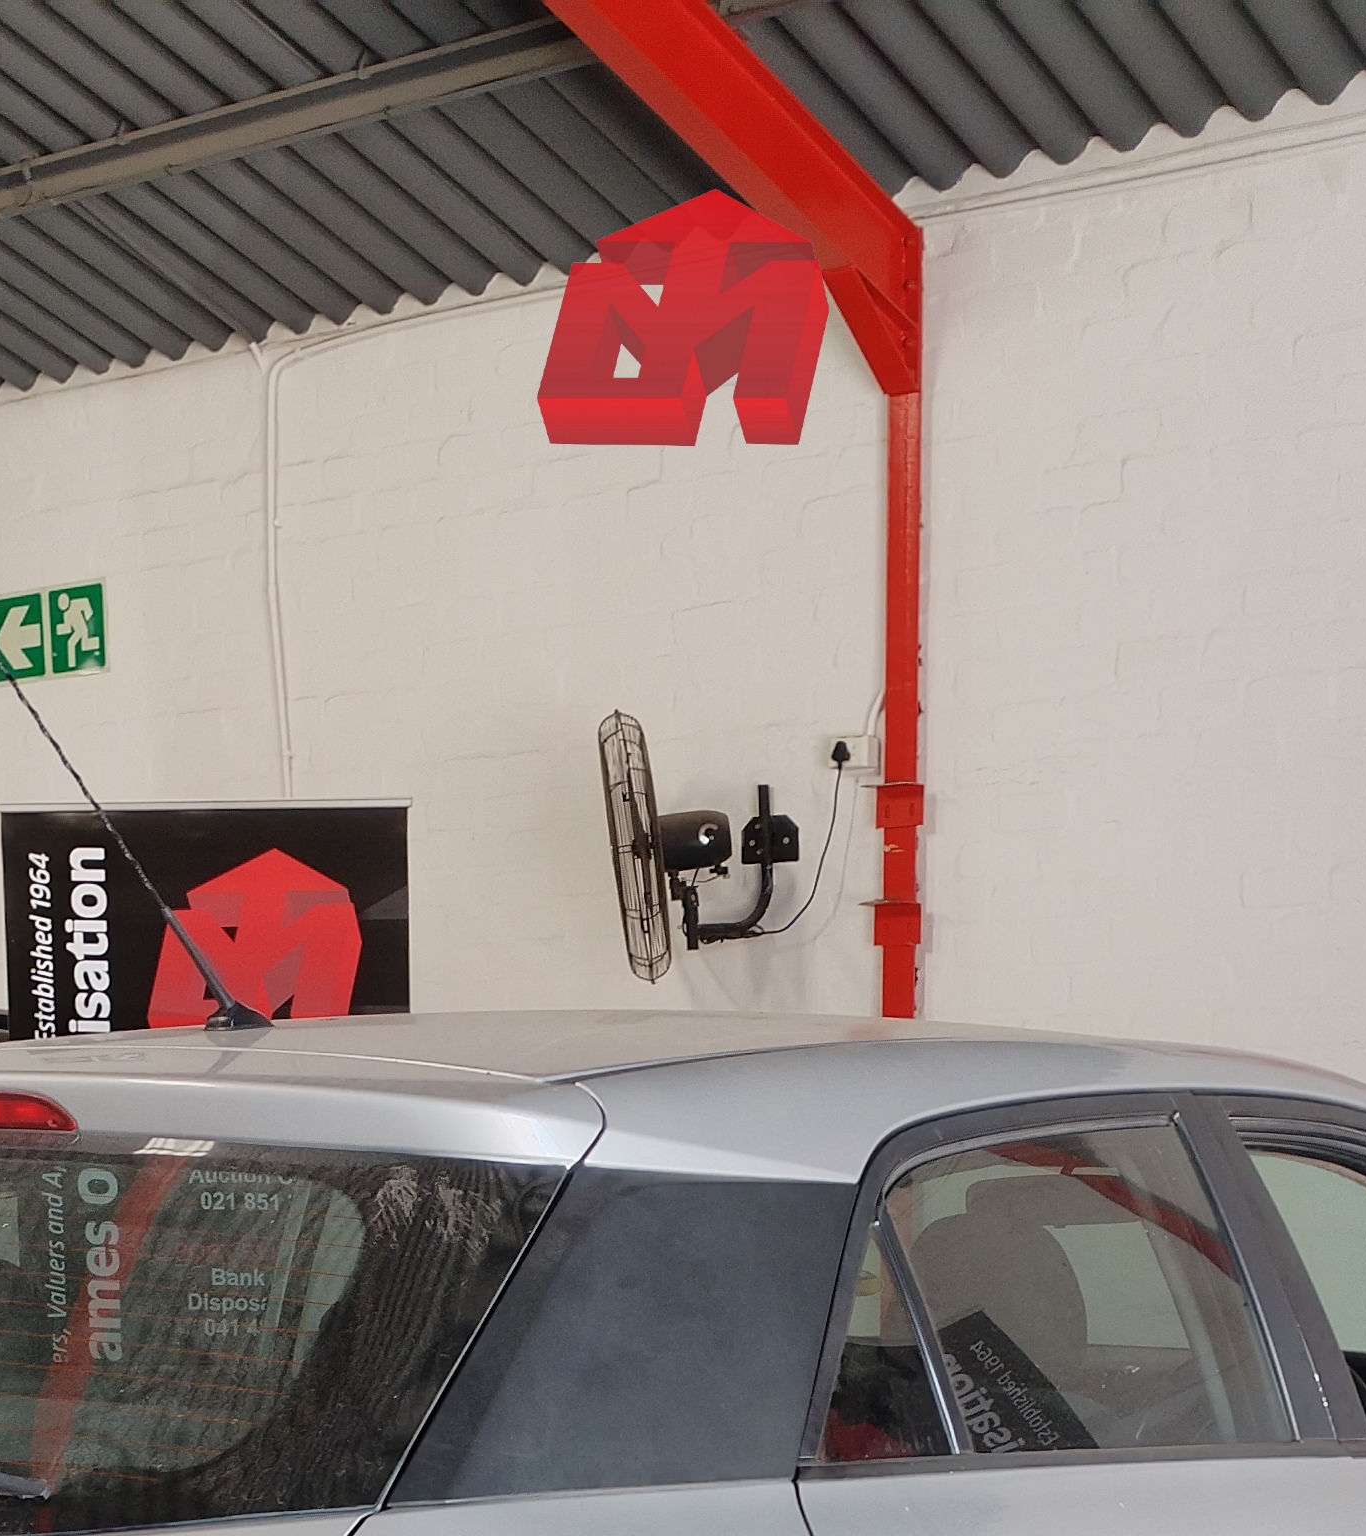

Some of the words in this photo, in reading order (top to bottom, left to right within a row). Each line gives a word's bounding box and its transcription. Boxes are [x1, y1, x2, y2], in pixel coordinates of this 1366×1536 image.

[28, 852, 52, 910] 1964
[41, 1192, 65, 1235] and
[200, 1191, 235, 1210] 021
[244, 1193, 279, 1211] 851
[44, 1239, 67, 1319] Valuers
[211, 1268, 265, 1286] Bank
